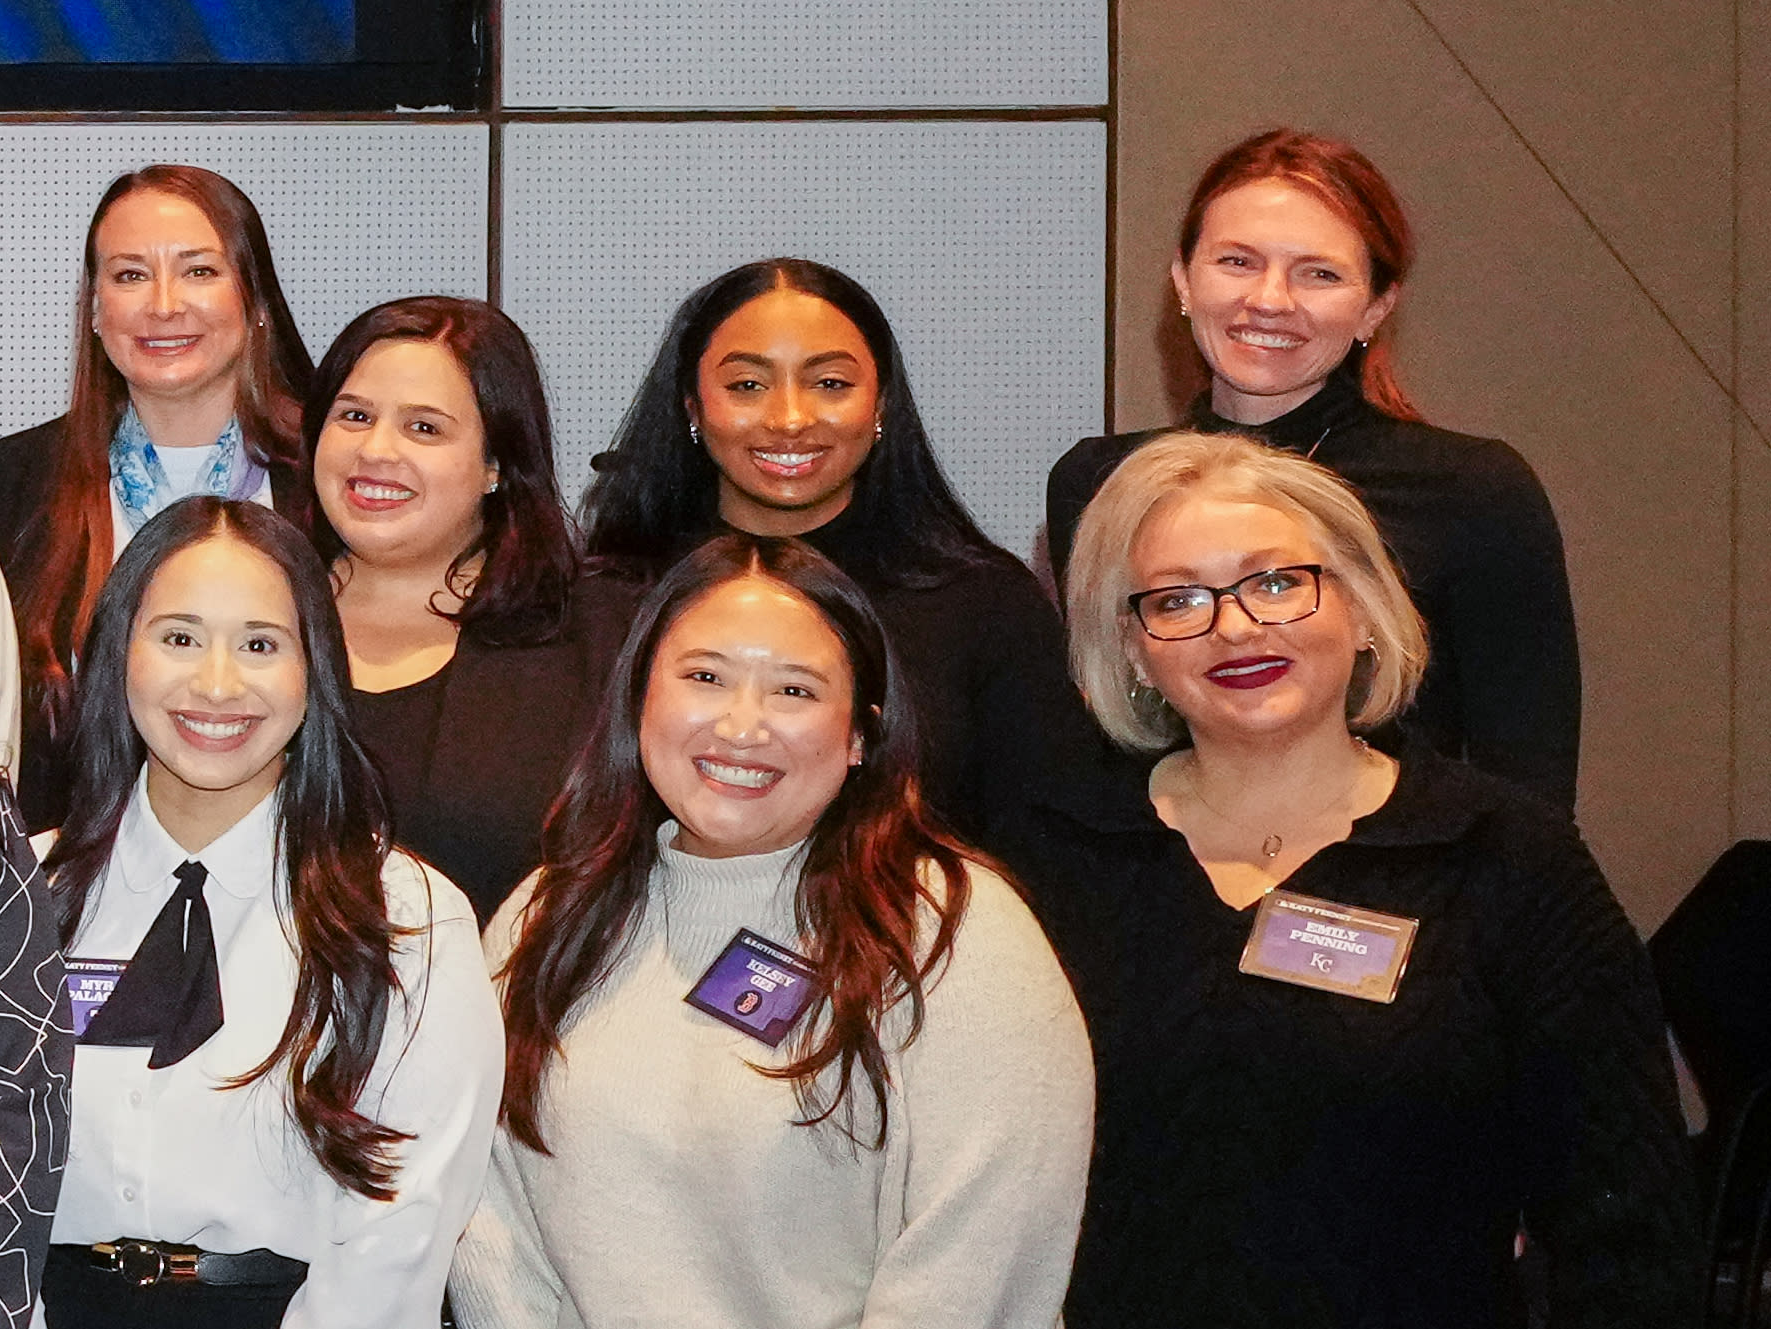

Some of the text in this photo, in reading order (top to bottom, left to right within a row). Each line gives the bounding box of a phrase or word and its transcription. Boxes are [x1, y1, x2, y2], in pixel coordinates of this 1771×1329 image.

[1289, 929, 1368, 955] PENNING
[1305, 921, 1360, 942] EMILY
[746, 958, 797, 987] KELSEY
[1310, 952, 1334, 973] KC
[80, 979, 114, 991] MYR
